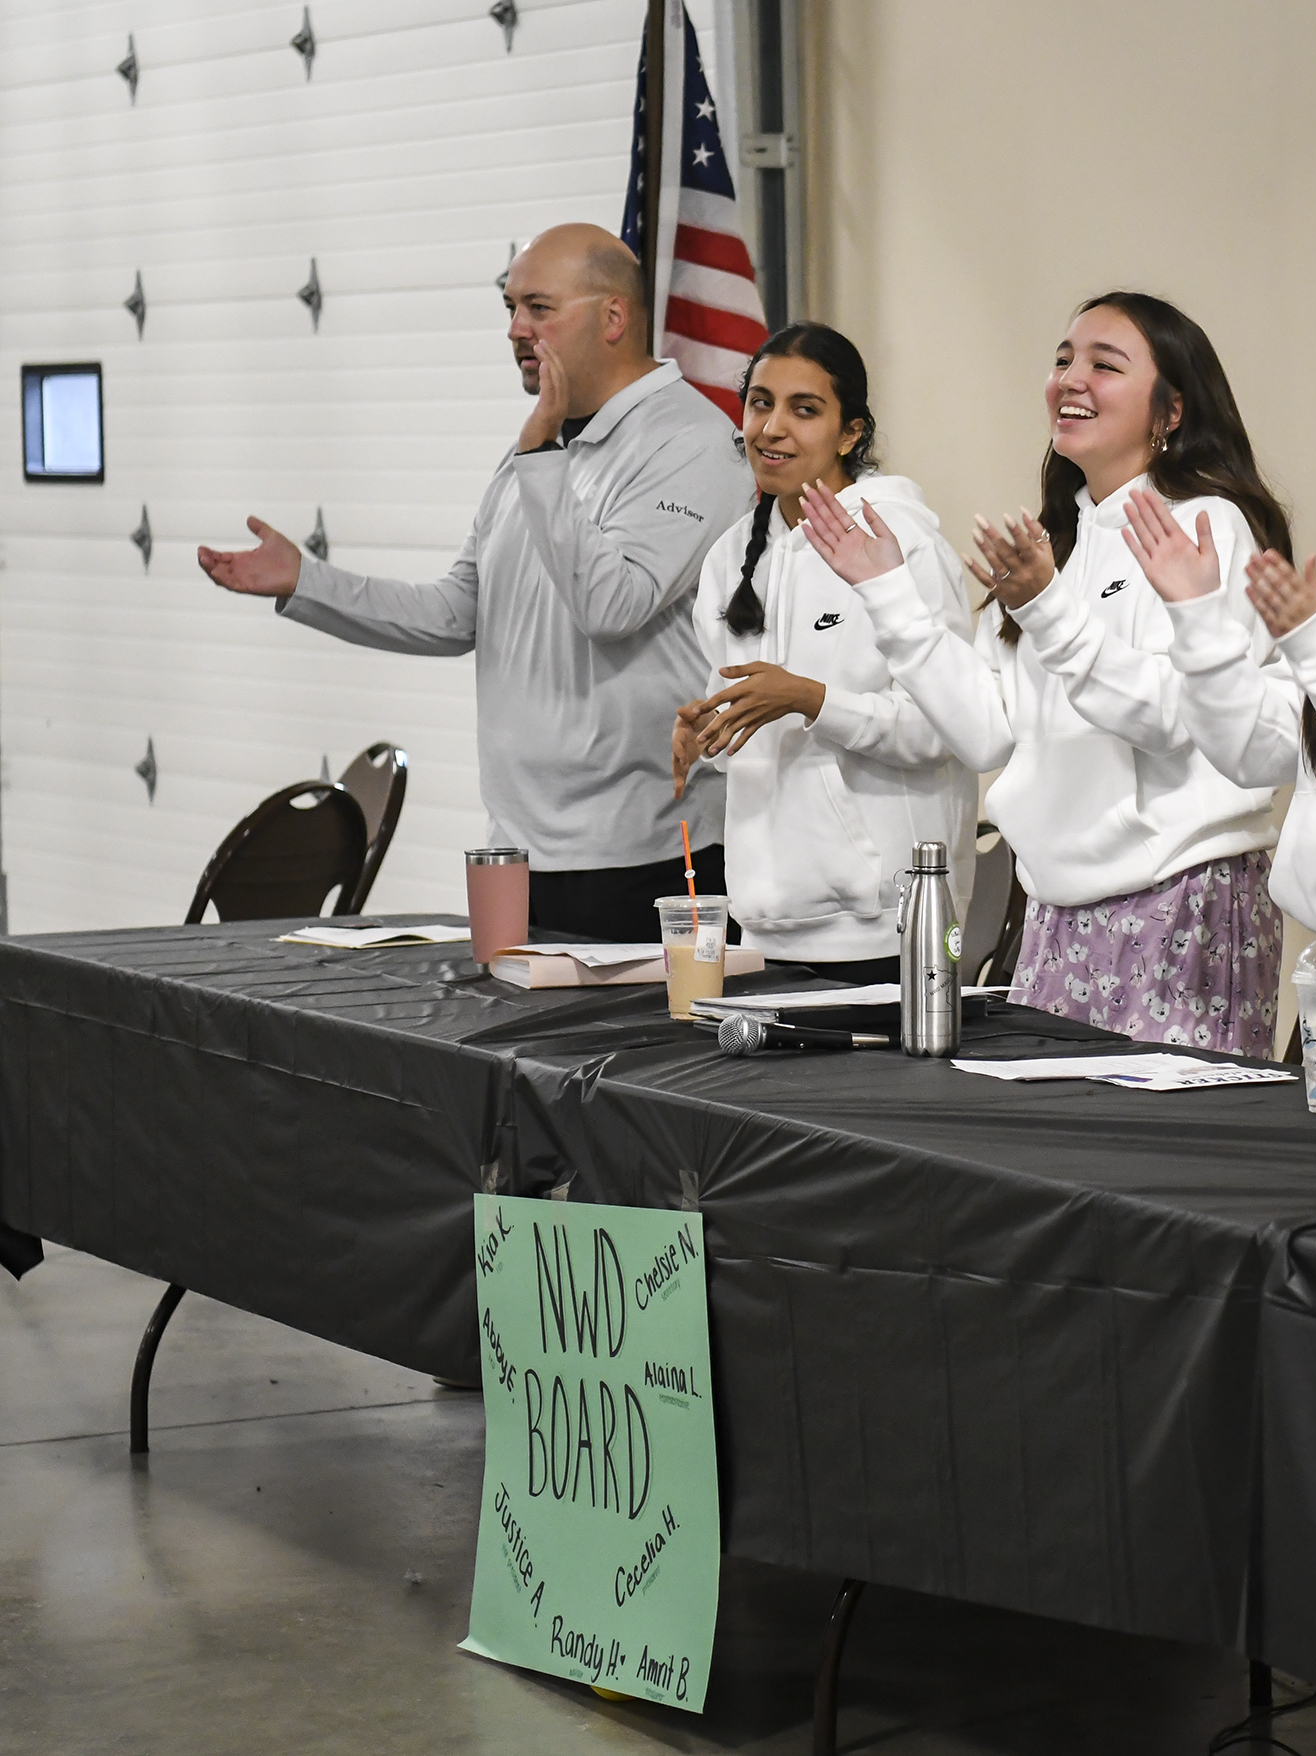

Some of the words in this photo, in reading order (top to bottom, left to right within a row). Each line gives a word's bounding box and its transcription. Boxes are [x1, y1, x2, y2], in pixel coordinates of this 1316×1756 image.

[533, 1221, 627, 1358] NWD
[524, 1368, 651, 1520] BOARD
[644, 1361, 687, 1394] Alaina
